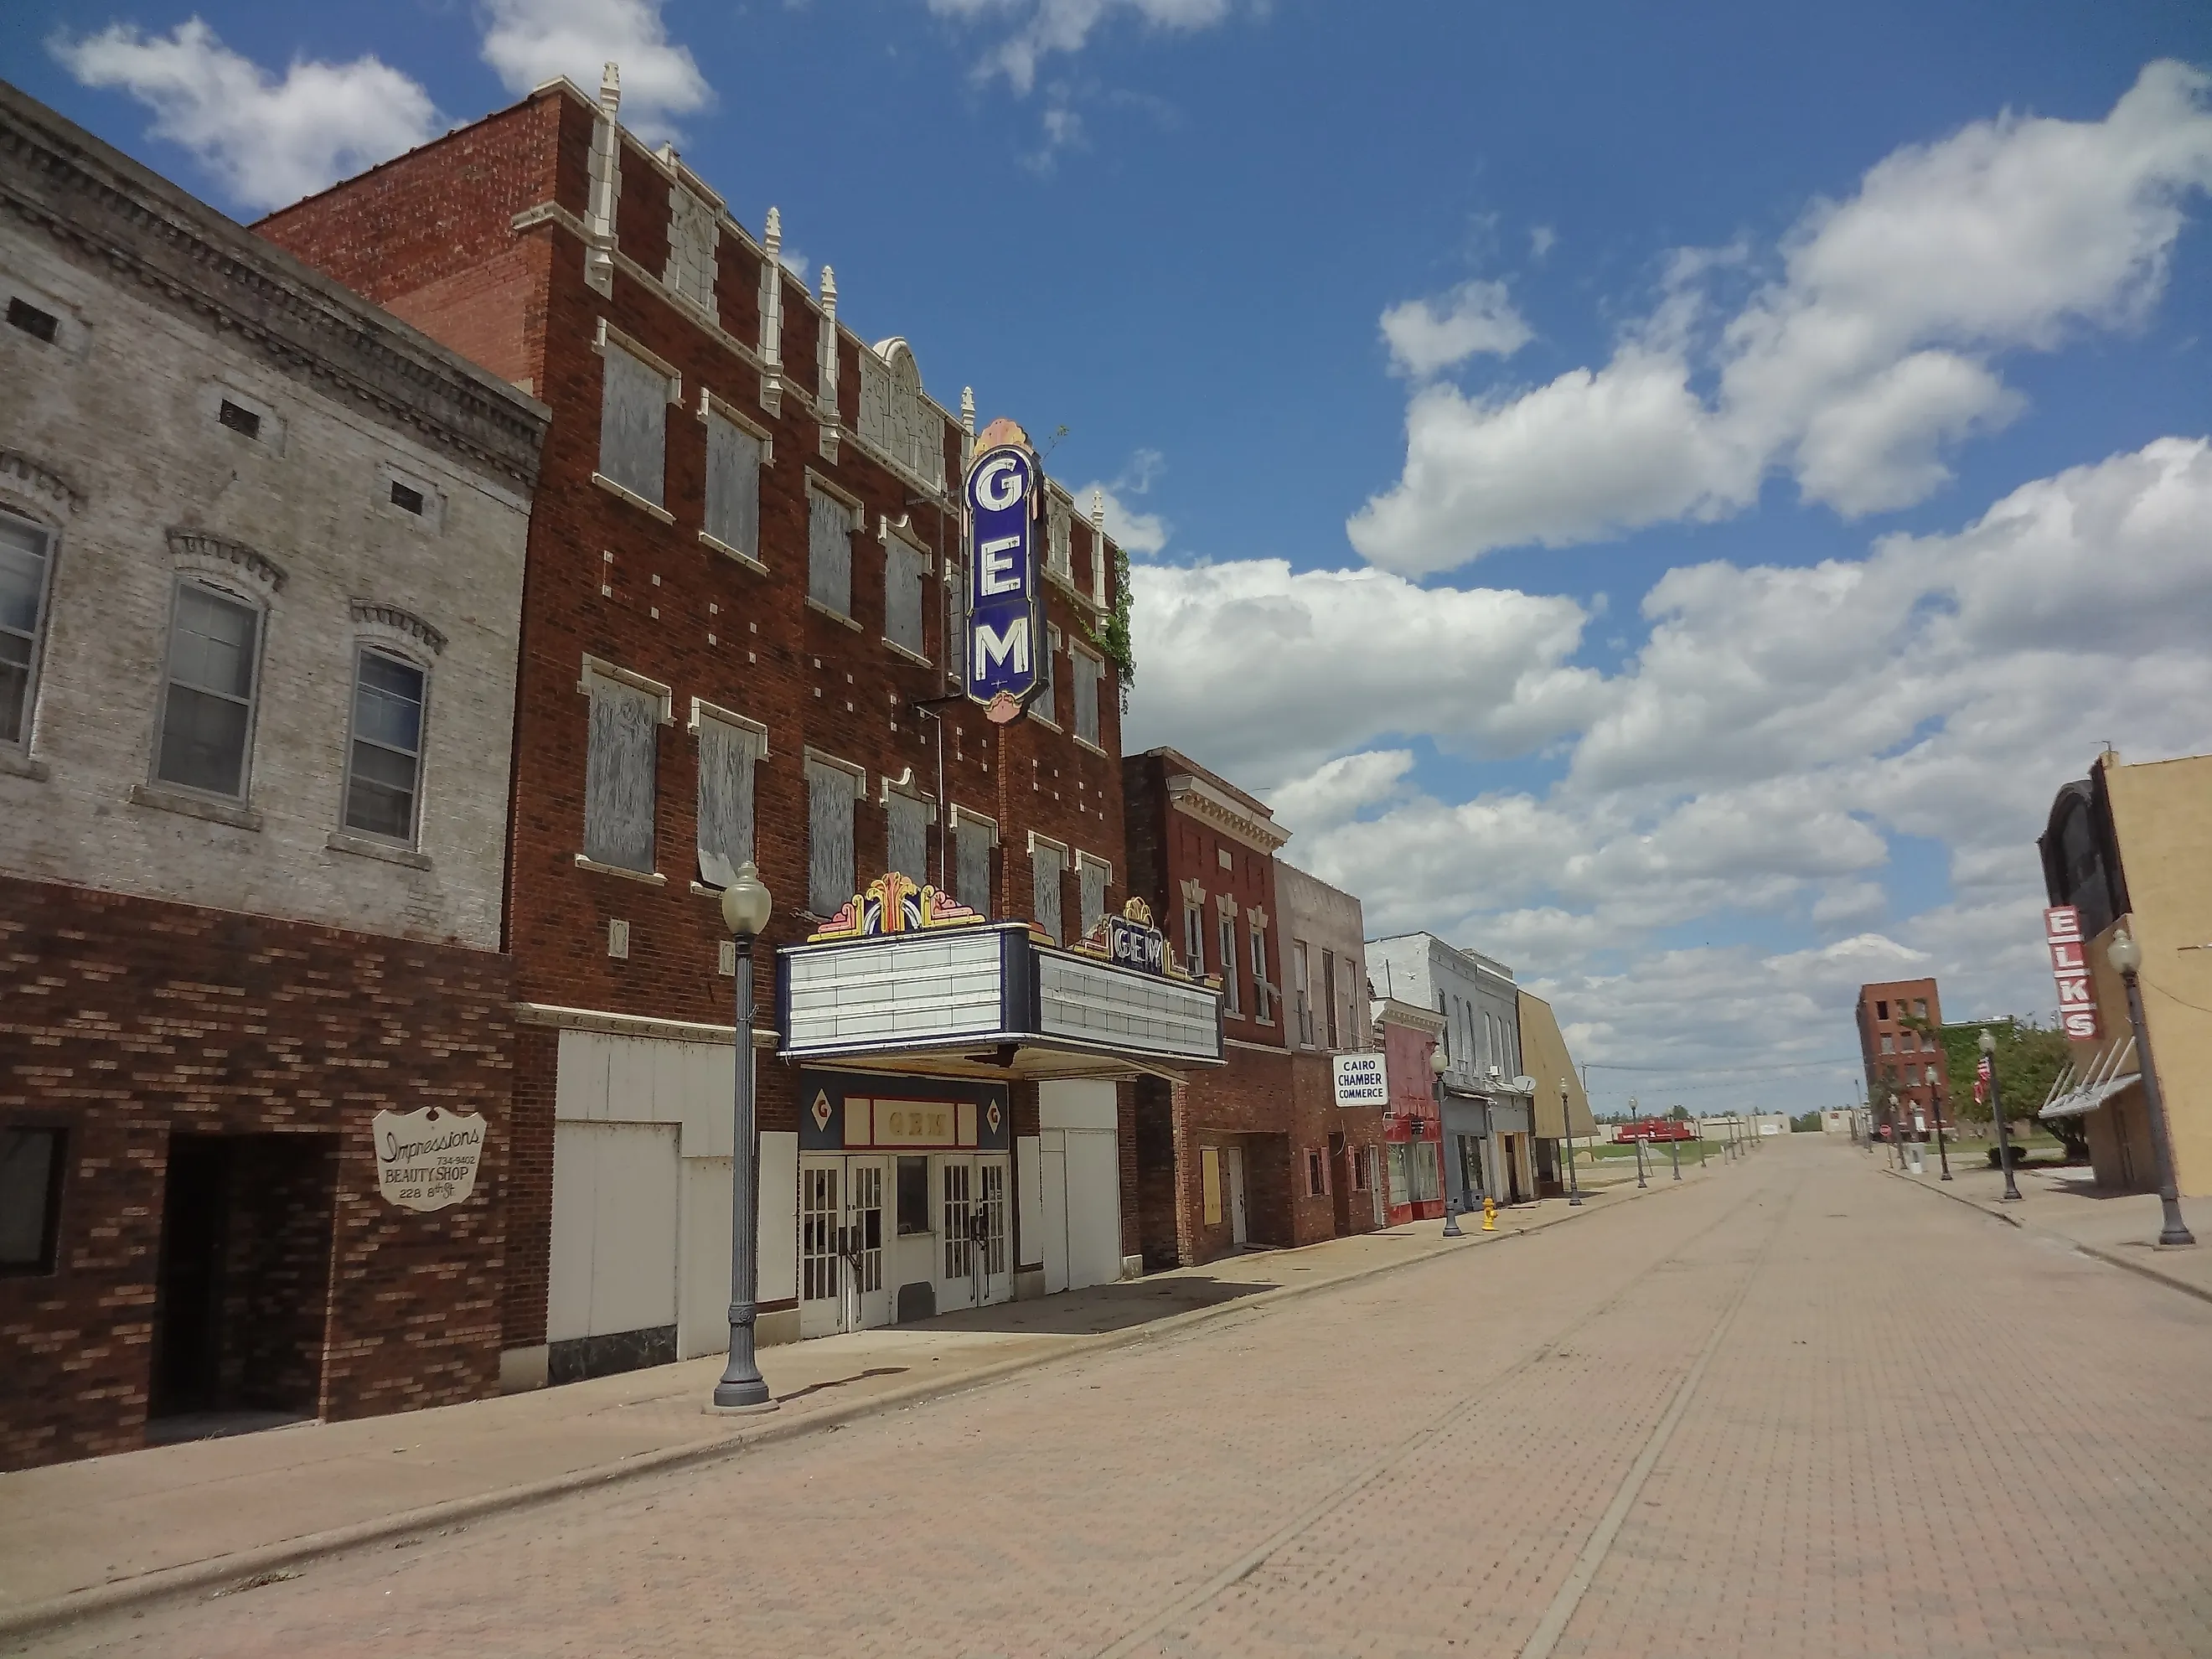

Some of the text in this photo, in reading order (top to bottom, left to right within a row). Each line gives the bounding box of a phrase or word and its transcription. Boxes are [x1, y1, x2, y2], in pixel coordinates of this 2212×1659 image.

[975, 458, 1029, 680] GEM
[1114, 928, 1161, 967] GEM
[2049, 911, 2096, 1037] ELKS
[1343, 1060, 1376, 1072] CAIRO
[1338, 1073, 1382, 1087] CHAMBER
[1339, 1088, 1383, 1099] COMMERCE
[818, 1100, 828, 1118] G
[990, 1108, 998, 1124] G
[380, 1129, 480, 1164] Impressions
[385, 1166, 468, 1183] BEAUTY SHOP
[400, 1188, 421, 1198] 228
[427, 1182, 442, 1198] 8th
